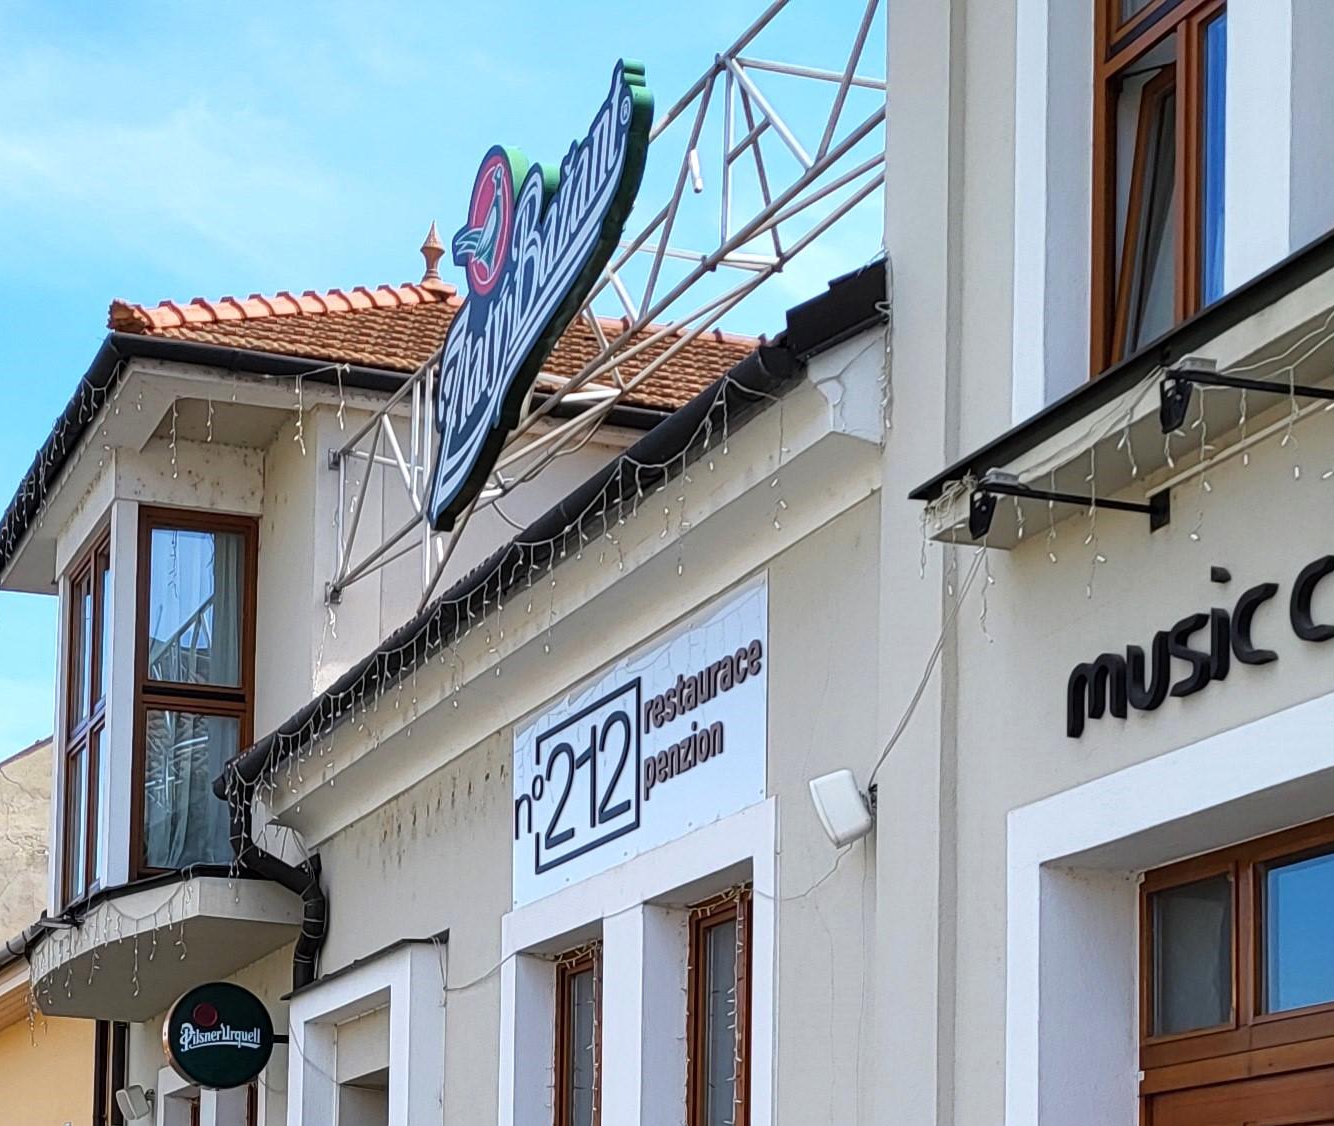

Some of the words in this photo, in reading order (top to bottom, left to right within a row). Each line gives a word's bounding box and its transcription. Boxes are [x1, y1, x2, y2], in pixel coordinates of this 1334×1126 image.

[512, 74, 625, 350] Bažant
[643, 639, 763, 735] restaurace
[1066, 565, 1279, 738] music
[643, 720, 724, 801] penzion
[179, 1022, 220, 1052] Pilsner
[220, 1022, 261, 1048] Urquell
